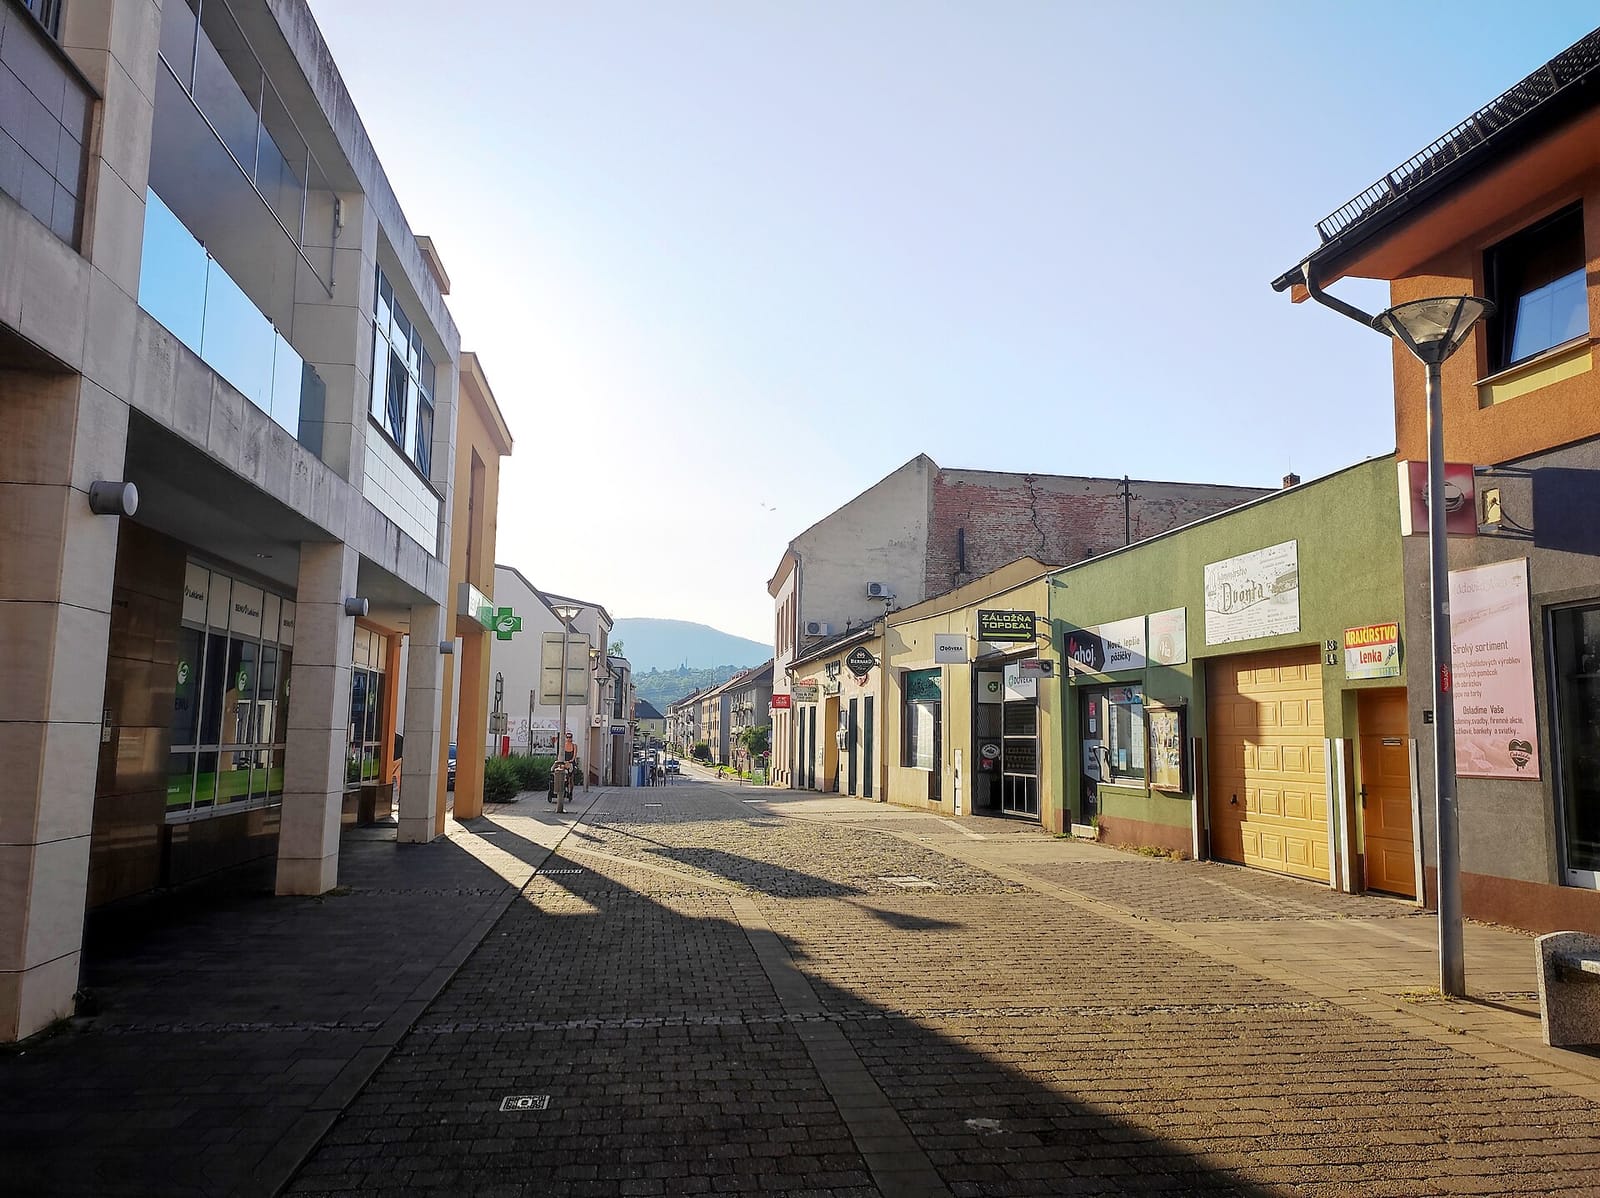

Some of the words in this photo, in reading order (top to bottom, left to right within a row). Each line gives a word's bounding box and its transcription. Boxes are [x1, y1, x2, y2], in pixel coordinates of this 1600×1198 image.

[982, 612, 1032, 622] ZÁLOŽŇA
[1453, 643, 1473, 655] Široký
[1475, 641, 1508, 652] sortiment
[1325, 654, 1335, 665] 14
[1490, 705, 1504, 714] Vaše
